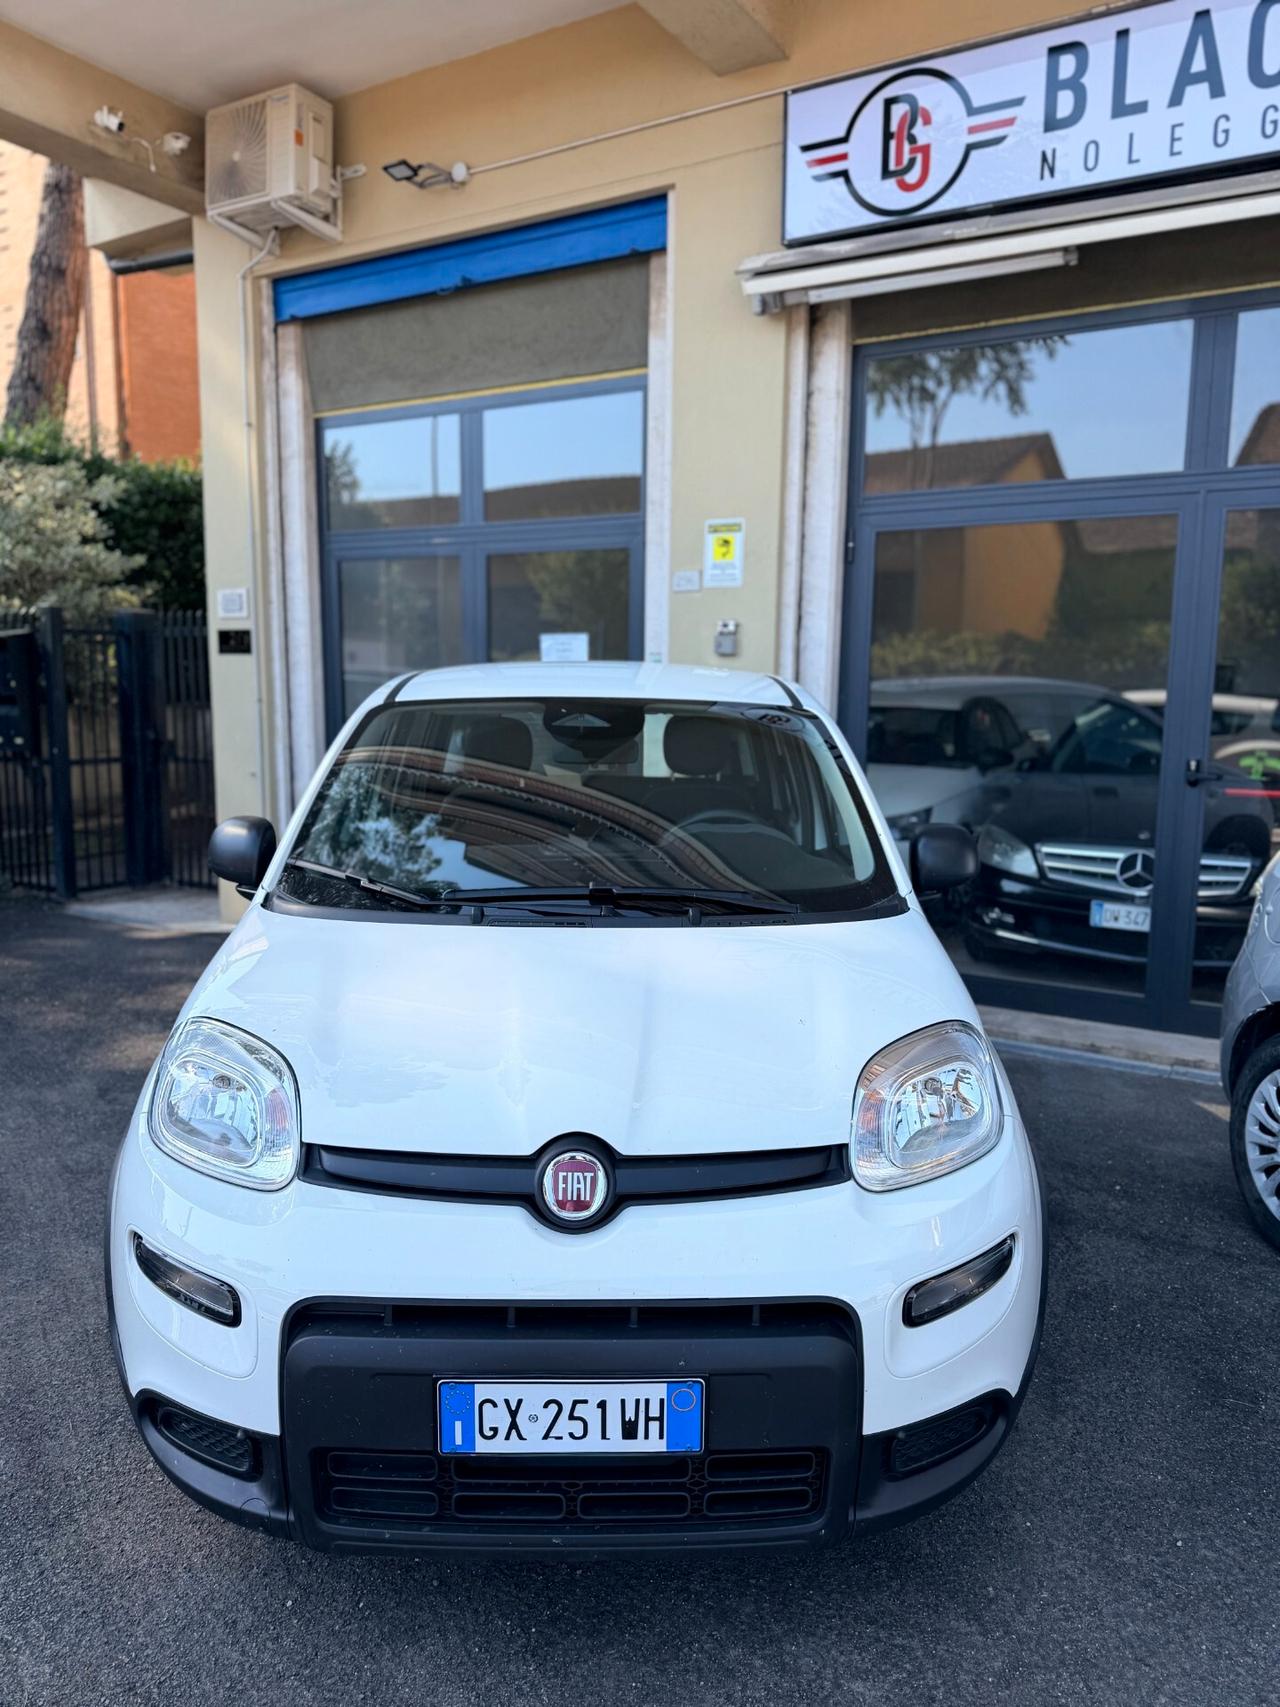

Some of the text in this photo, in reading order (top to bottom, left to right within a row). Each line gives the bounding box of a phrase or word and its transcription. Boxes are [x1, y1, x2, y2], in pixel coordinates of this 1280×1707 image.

[1043, 0, 1280, 133] BLAC
[1039, 104, 1280, 181] NOLEGG
[558, 1172, 594, 1201] FIAT
[478, 1398, 527, 1440] GX
